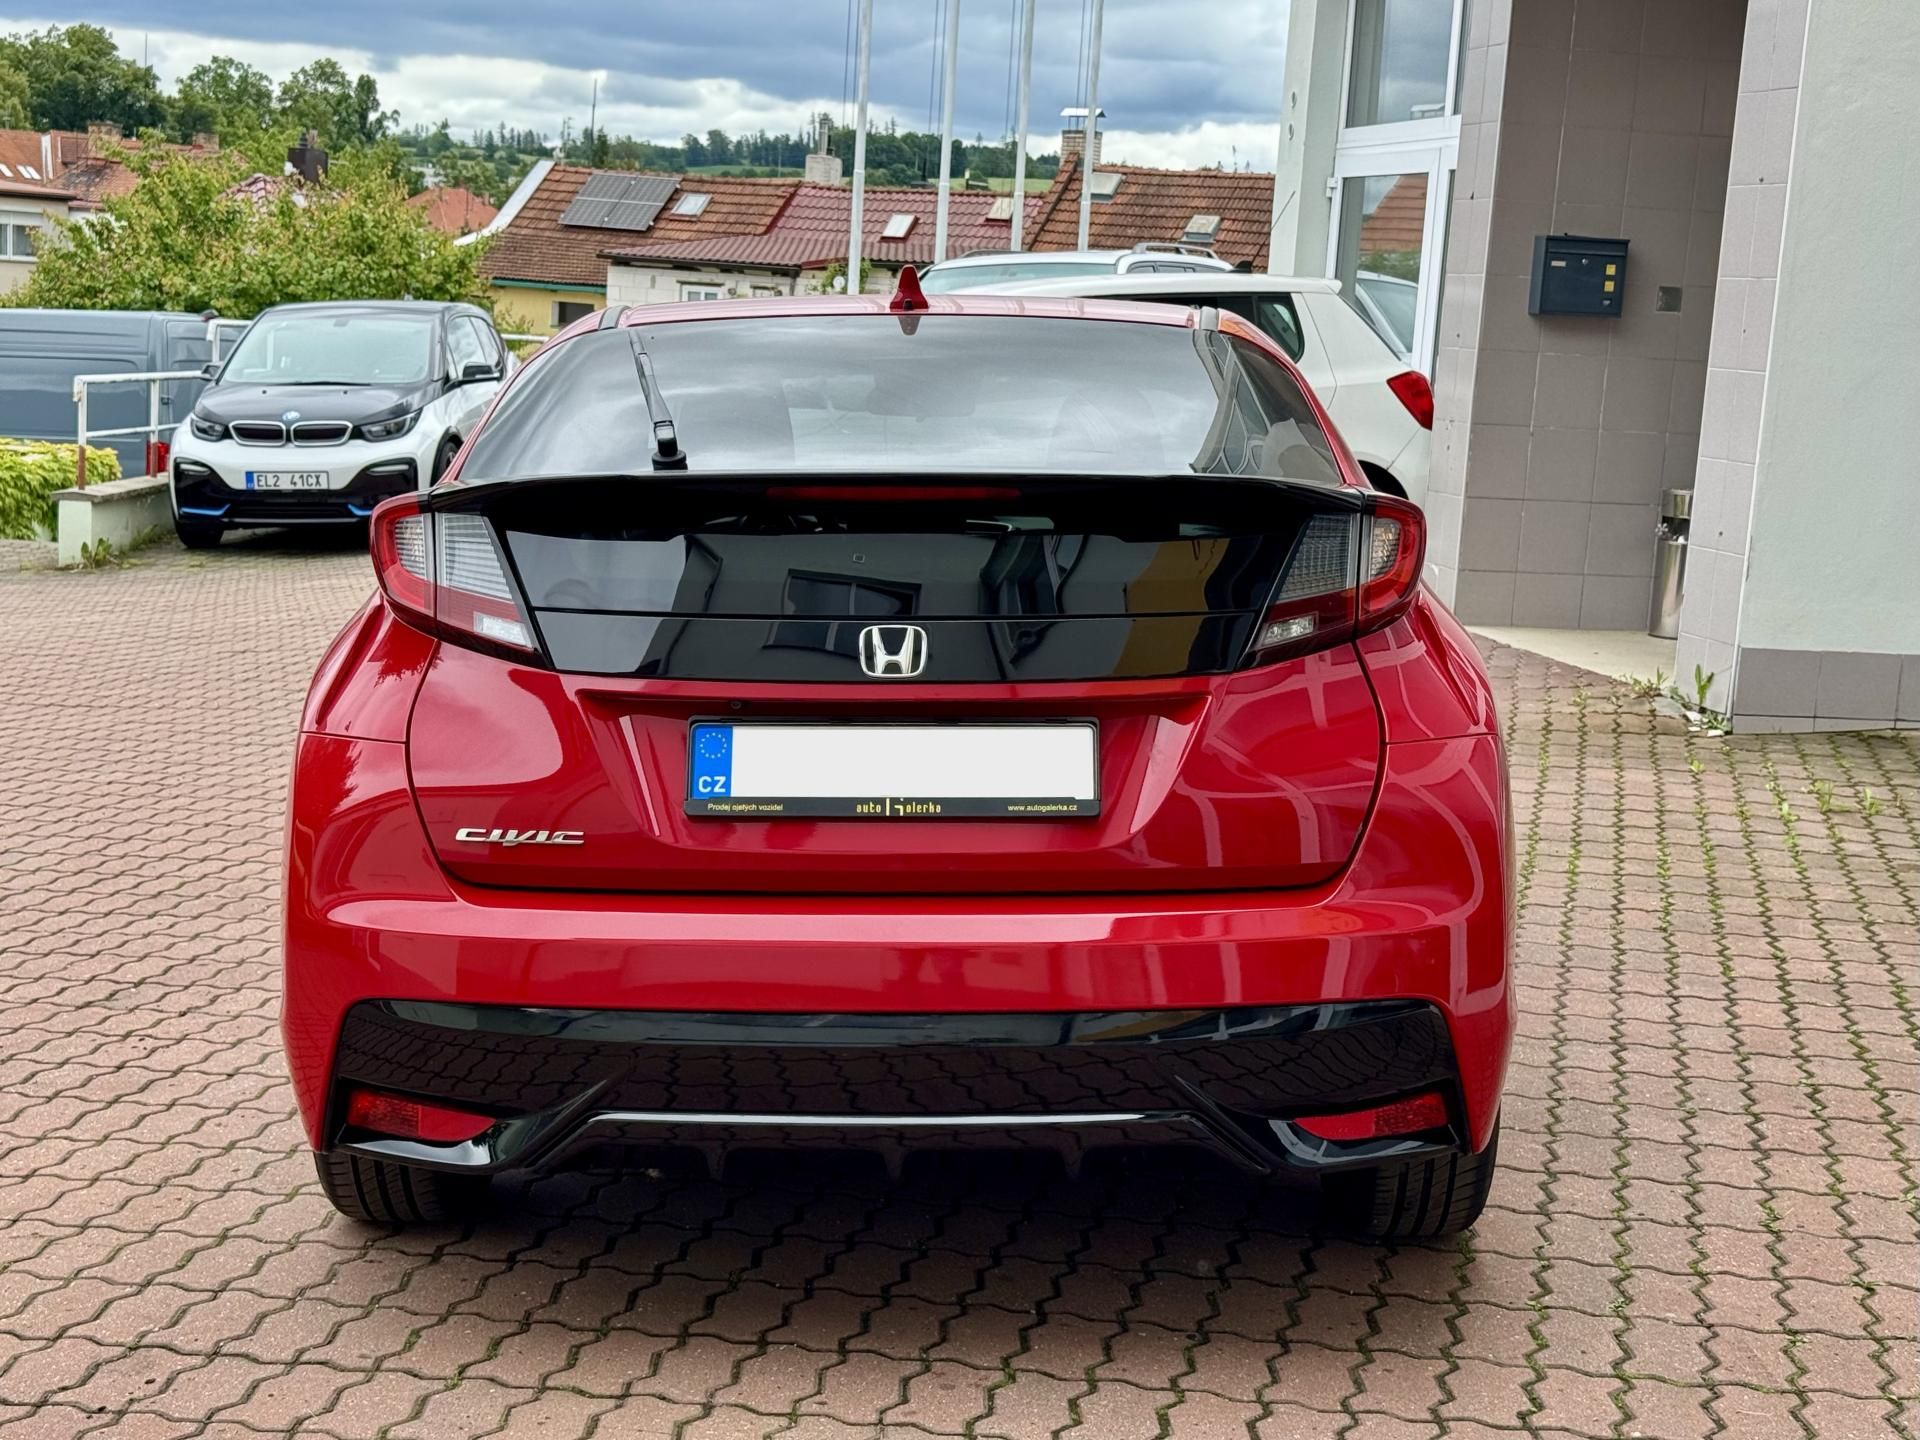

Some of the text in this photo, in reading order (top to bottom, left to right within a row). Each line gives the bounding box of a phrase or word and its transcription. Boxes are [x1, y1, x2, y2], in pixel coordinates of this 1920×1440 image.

[256, 474, 280, 487] EL2
[290, 474, 321, 487] 41CX
[698, 775, 726, 793] CZ
[707, 803, 731, 812] Prodej
[759, 803, 784, 811] vozidel
[1007, 804, 1078, 813] www.autogalerka.cz
[455, 828, 585, 847] CIVIC
